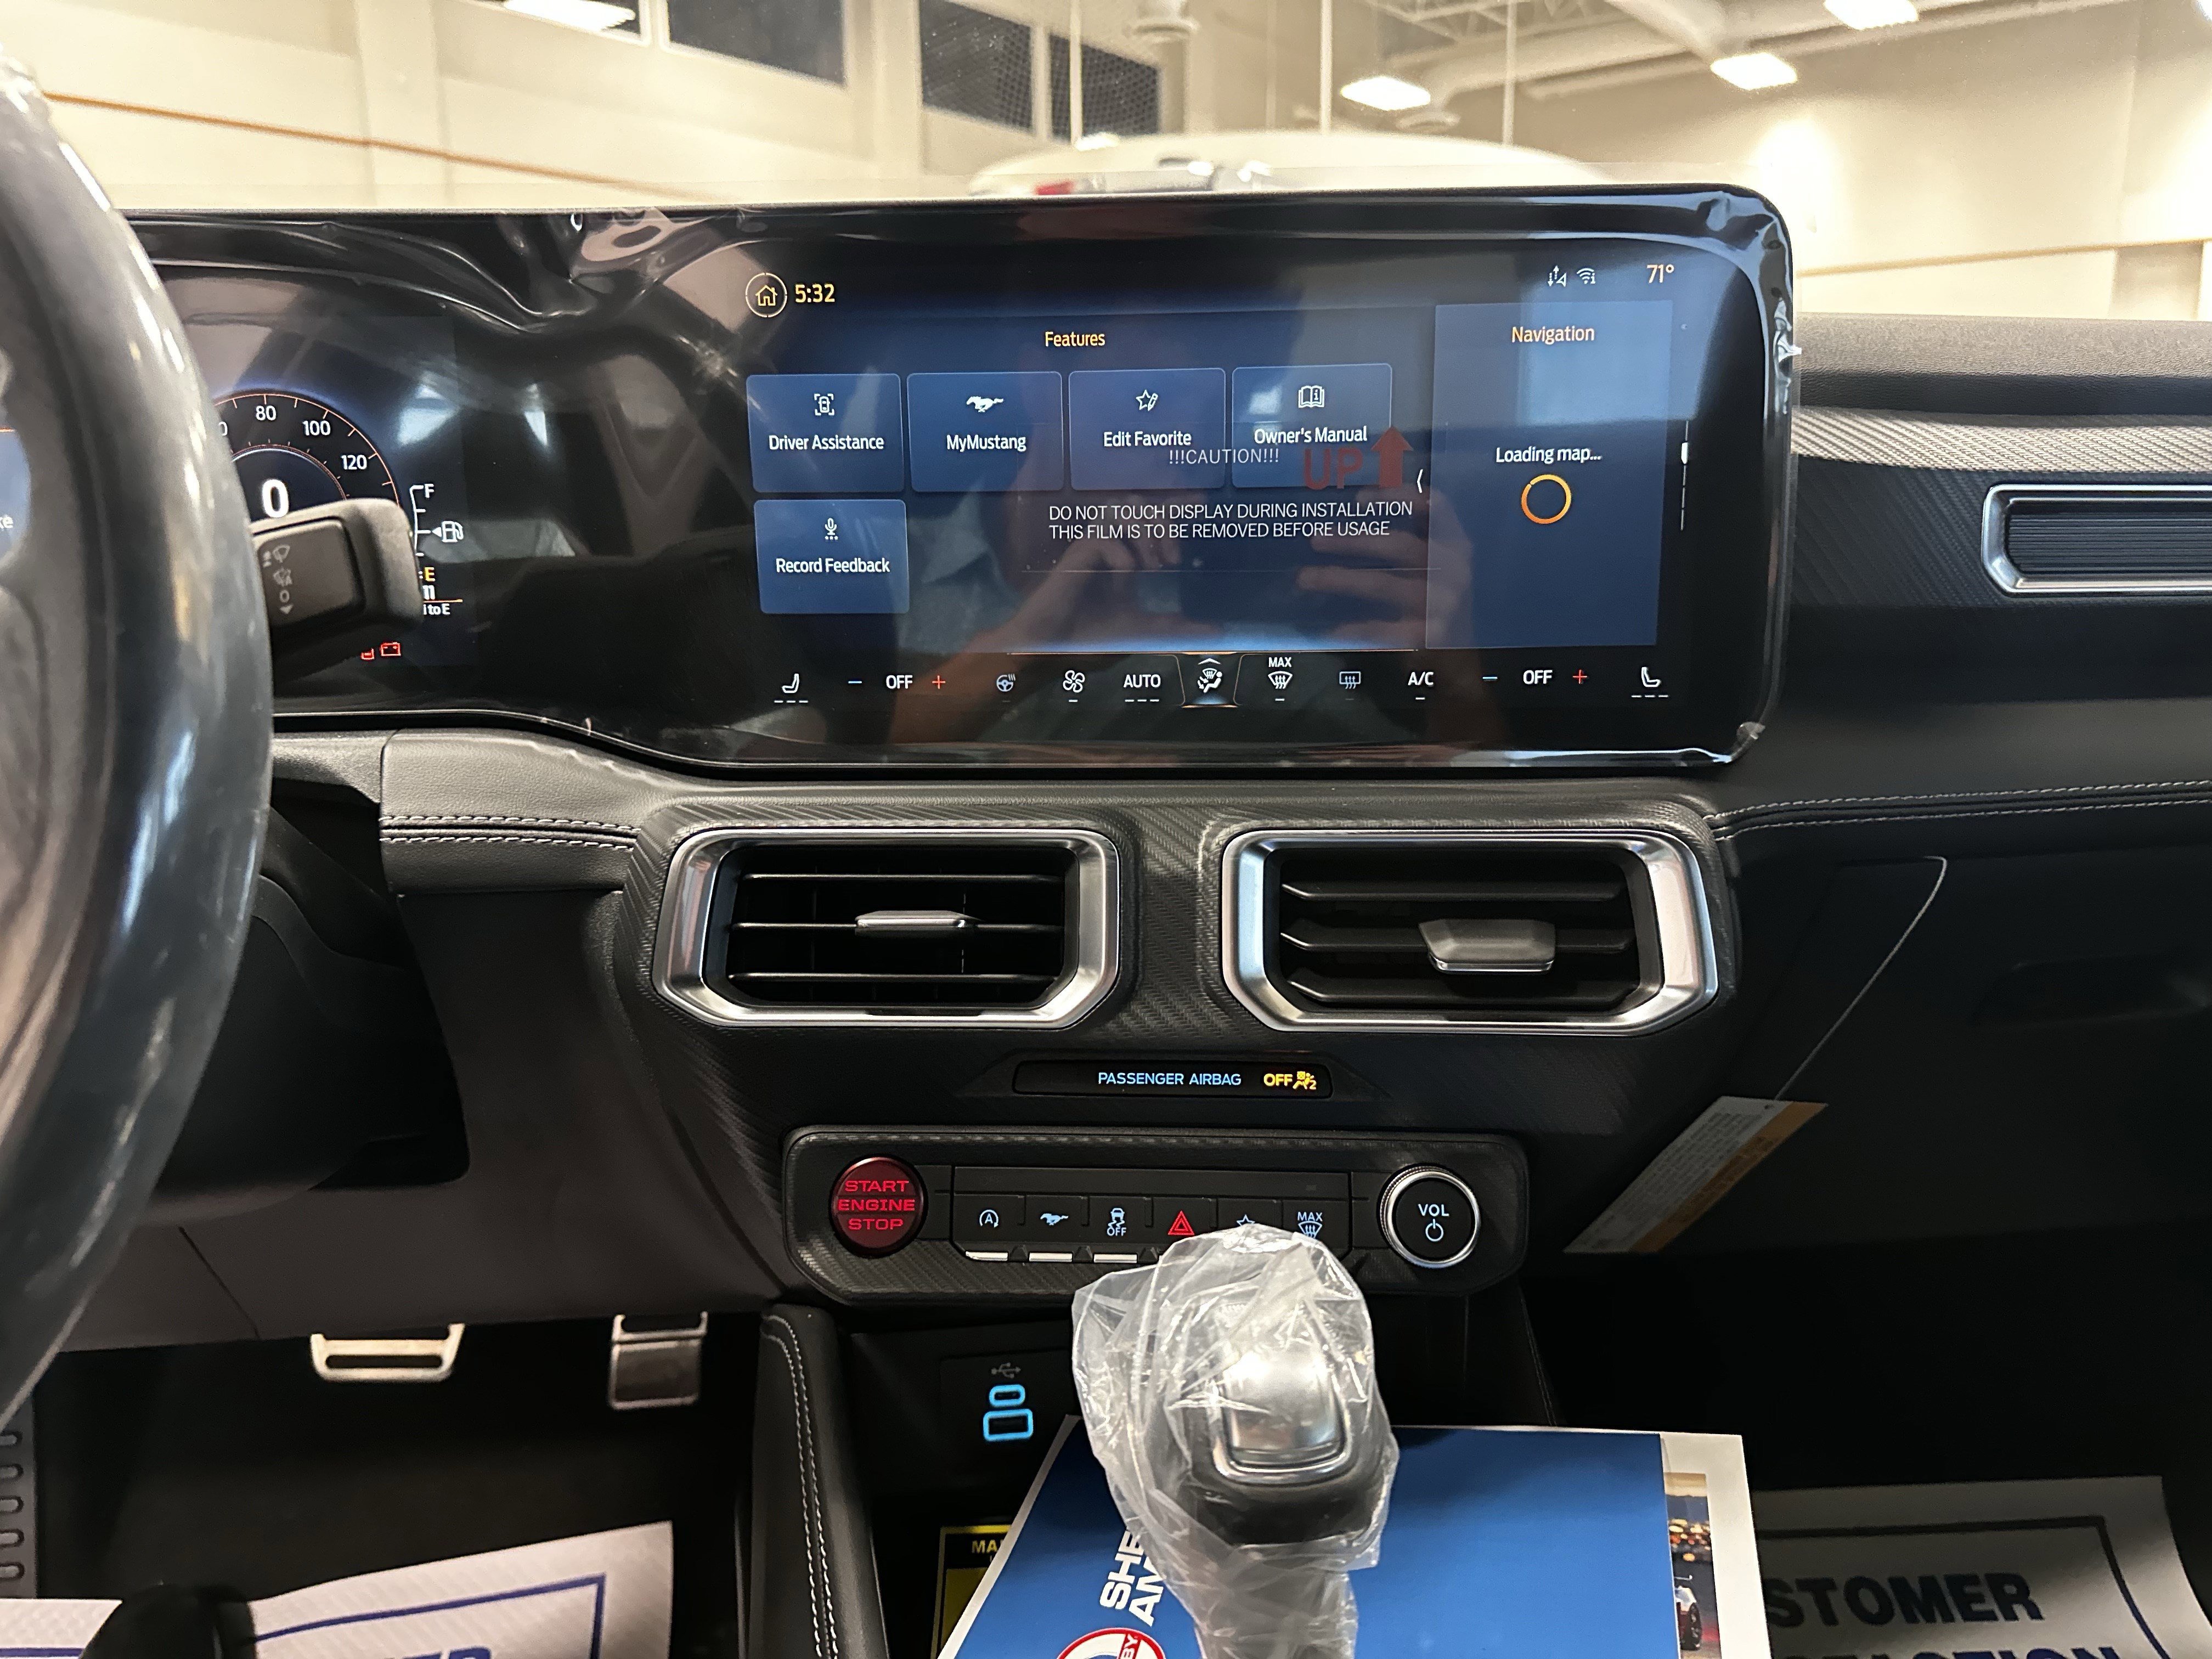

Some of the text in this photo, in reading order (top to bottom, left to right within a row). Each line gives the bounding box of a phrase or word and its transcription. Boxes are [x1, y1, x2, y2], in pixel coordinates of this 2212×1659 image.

[795, 284, 835, 303] 5:32
[1045, 331, 1105, 347] Features
[1511, 326, 1595, 345] Navigation
[256, 405, 276, 421] 80
[303, 420, 330, 436] 100
[1254, 426, 1367, 445] Owner's Manual
[769, 434, 884, 451] Driver Assistance
[946, 434, 1026, 453] MyMustang
[1103, 430, 1192, 447] Edit Favorite
[341, 454, 367, 470] 120
[1169, 449, 1279, 465] !!!CAUTION!!!
[1496, 447, 1601, 464] Loading map...
[1304, 447, 1363, 489] UP
[261, 478, 289, 518] 0
[424, 484, 434, 498] F
[1049, 501, 1412, 521] DO NOT TOUCH DISPLAY DURING INSTALLATION
[1049, 521, 1390, 540] THIS FILM IS TO BE REMOVED BEFORE USAGE
[776, 557, 890, 573] Record Feedback
[424, 567, 435, 582] E
[1268, 657, 1292, 668] MAX
[885, 675, 913, 690] OFF
[1124, 674, 1161, 689] AUTO
[1408, 672, 1434, 686] A/C
[1523, 670, 1553, 685] OFF
[1098, 1073, 1242, 1086] PASSENGER AIRBAG
[1263, 1073, 1293, 1086] OFF
[845, 1180, 909, 1192] START
[838, 1199, 915, 1211] ENGINE
[1418, 1203, 1449, 1217] VOL
[848, 1218, 904, 1230] STOP
[1297, 1211, 1323, 1222] MAX
[1107, 1227, 1126, 1237] OFF
[972, 1539, 1004, 1554] MA
